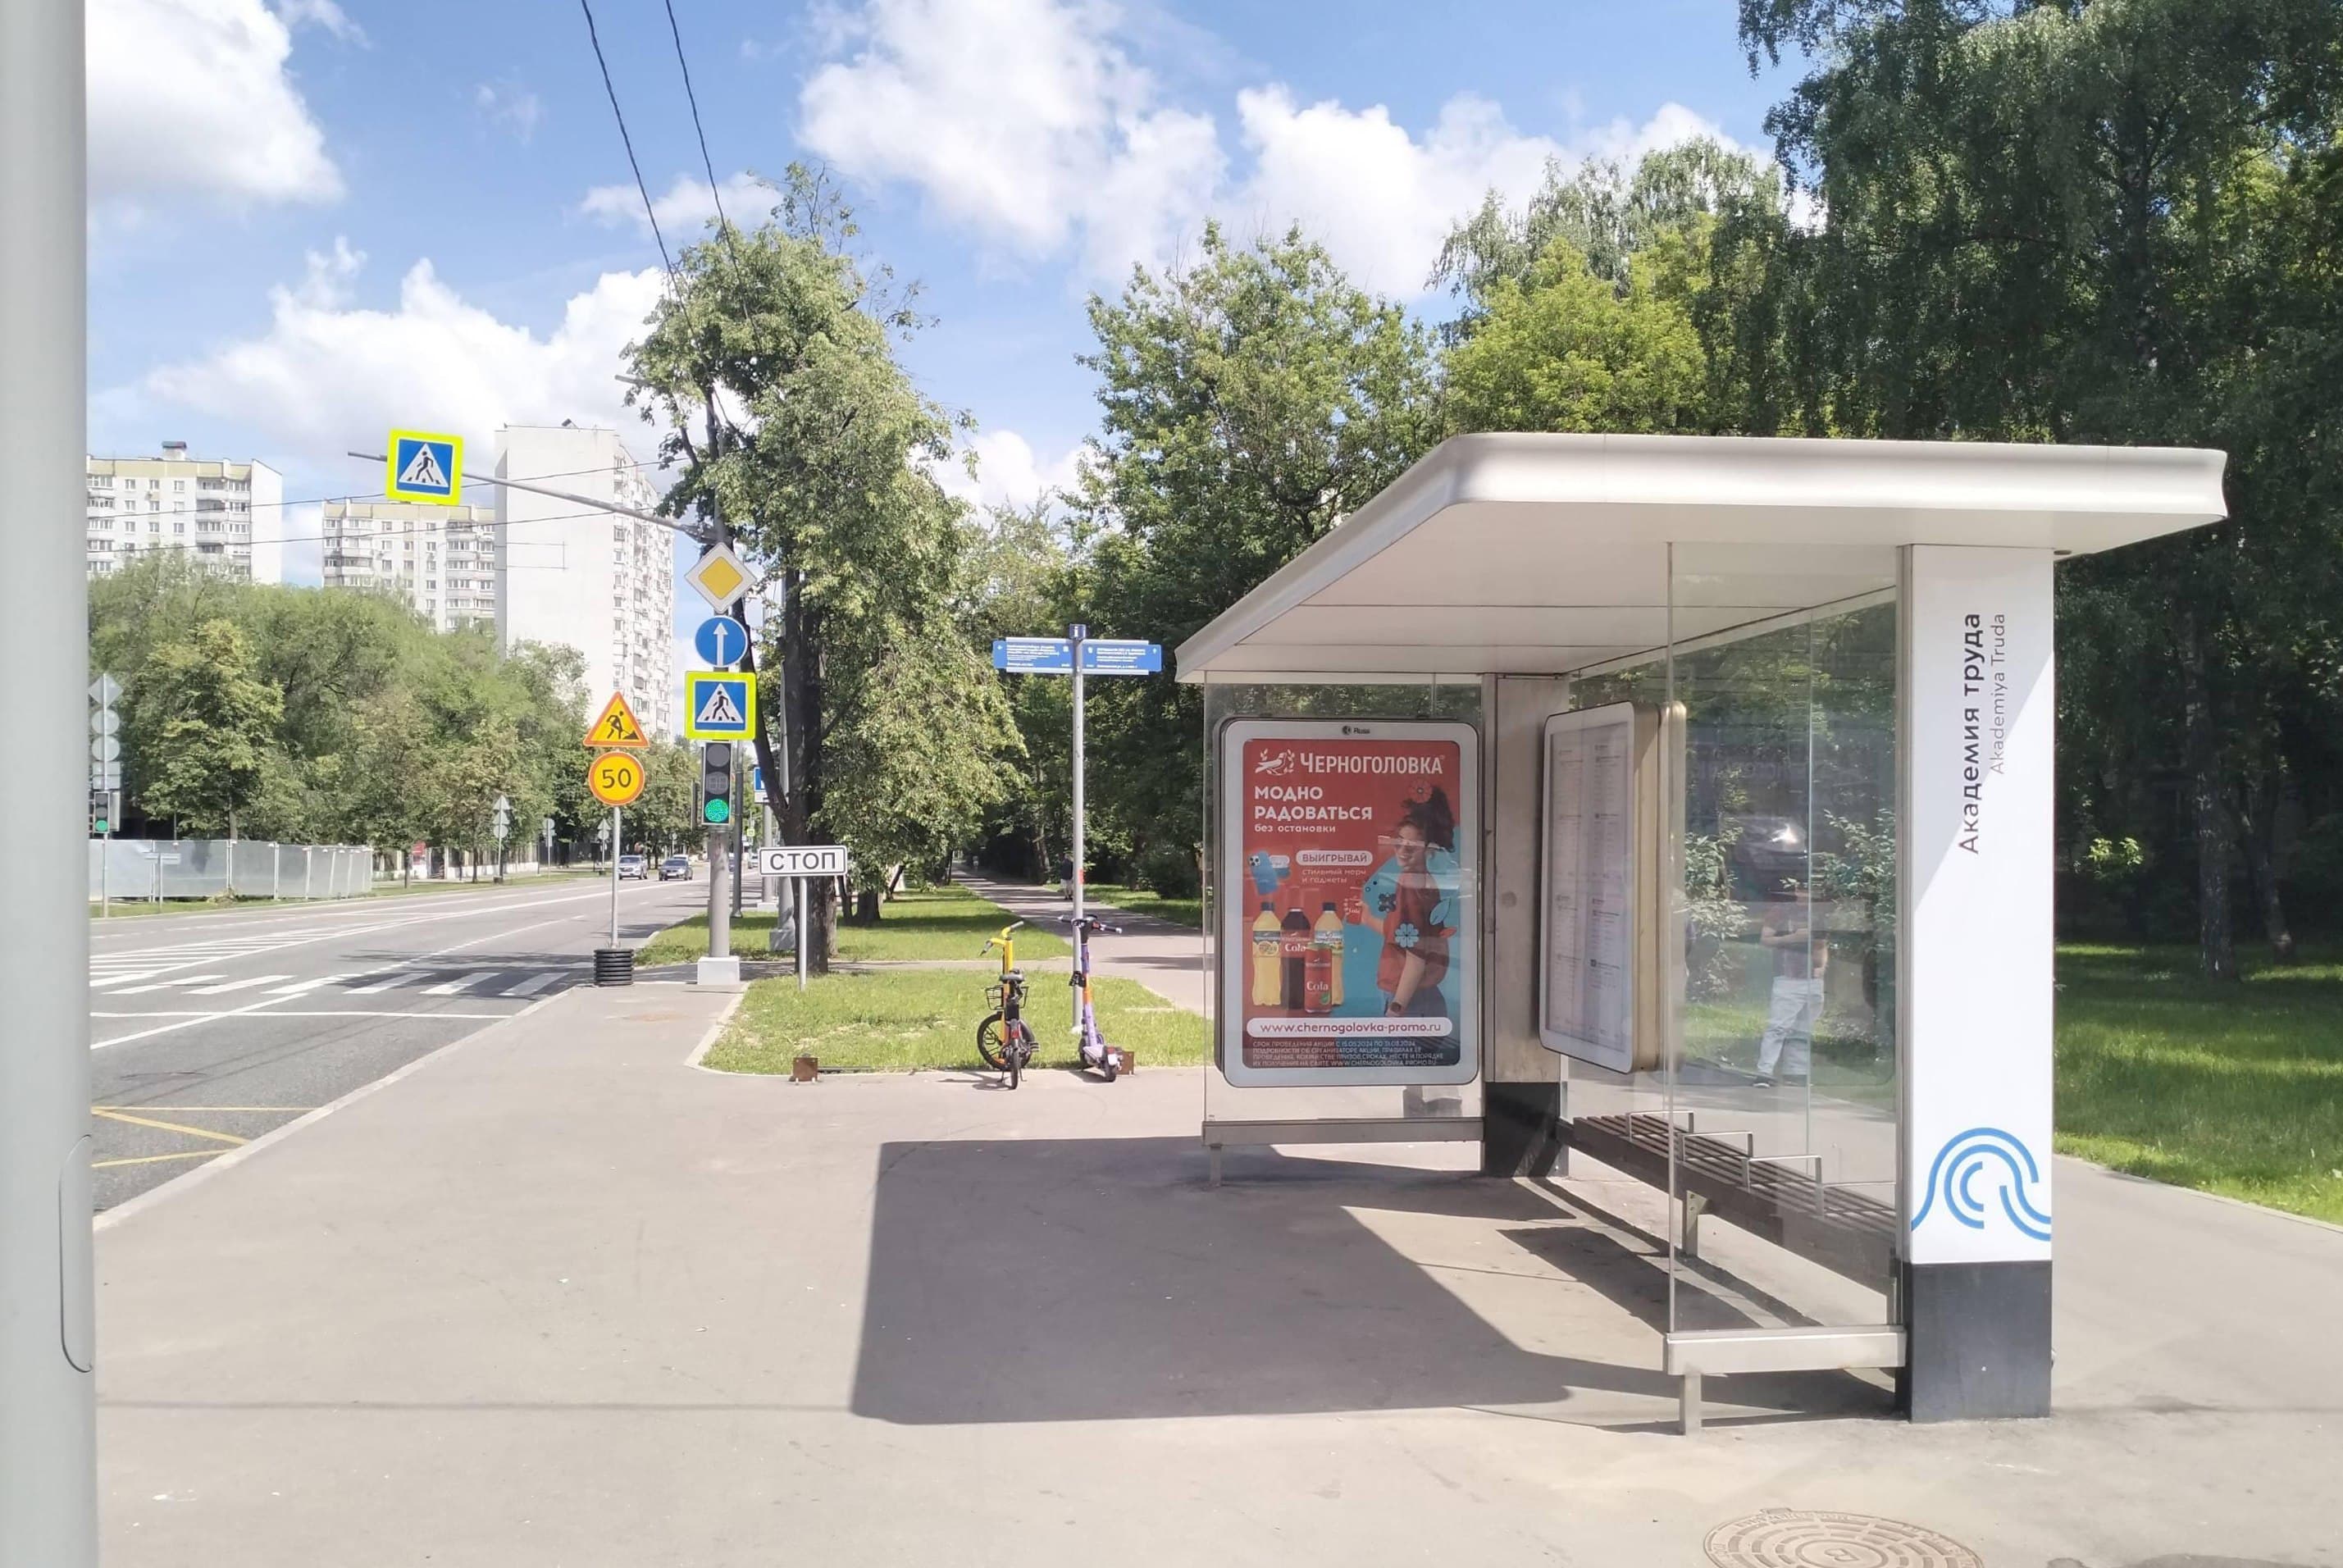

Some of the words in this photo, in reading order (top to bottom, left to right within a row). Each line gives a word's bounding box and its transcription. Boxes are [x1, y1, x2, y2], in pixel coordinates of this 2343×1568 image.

[1990, 613, 2005, 667] Truda
[1964, 613, 1985, 696] труда
[1990, 672, 2008, 774] Akademiya
[1300, 752, 1443, 774] ЧЕРНОГОЛОВКА
[601, 768, 632, 789] 50
[1958, 709, 1982, 854] Академия
[1255, 786, 1323, 802] МОДНО
[1255, 805, 1373, 822] РАДОВАТЬСЯ
[1255, 824, 1273, 832] без
[1278, 825, 1336, 833] остановки
[769, 852, 836, 871] СТОП
[1302, 852, 1368, 862] ВЫИГРЫВАЙ
[1285, 943, 1306, 952] Cola
[1306, 981, 1329, 991] Cola
[1260, 1023, 1441, 1034] www.chernogolovka-promo.ru
